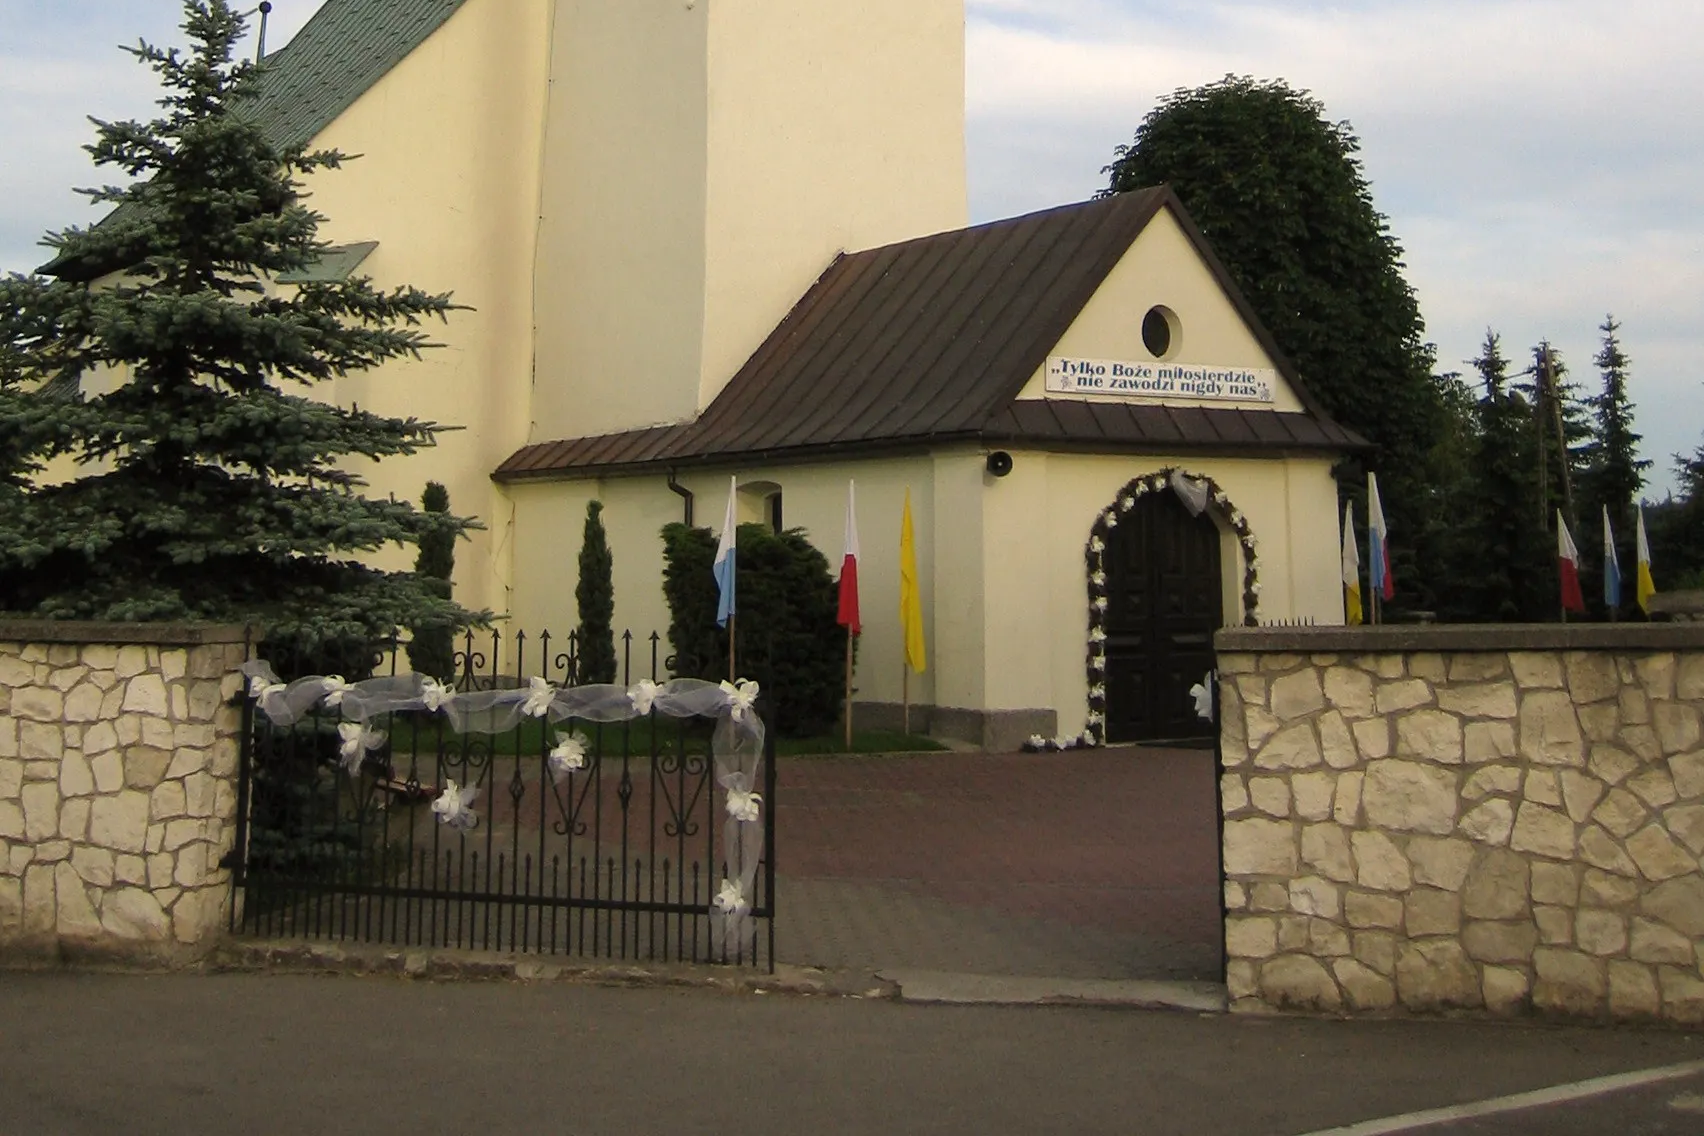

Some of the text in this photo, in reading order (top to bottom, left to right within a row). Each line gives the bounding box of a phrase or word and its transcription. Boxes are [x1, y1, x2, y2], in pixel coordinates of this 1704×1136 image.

[1113, 363, 1152, 378] Boże
[1158, 366, 1256, 384] miłosierdzie
[1077, 375, 1103, 388] nie
[1109, 377, 1174, 392] zawodzi
[1180, 380, 1225, 396] nigdy
